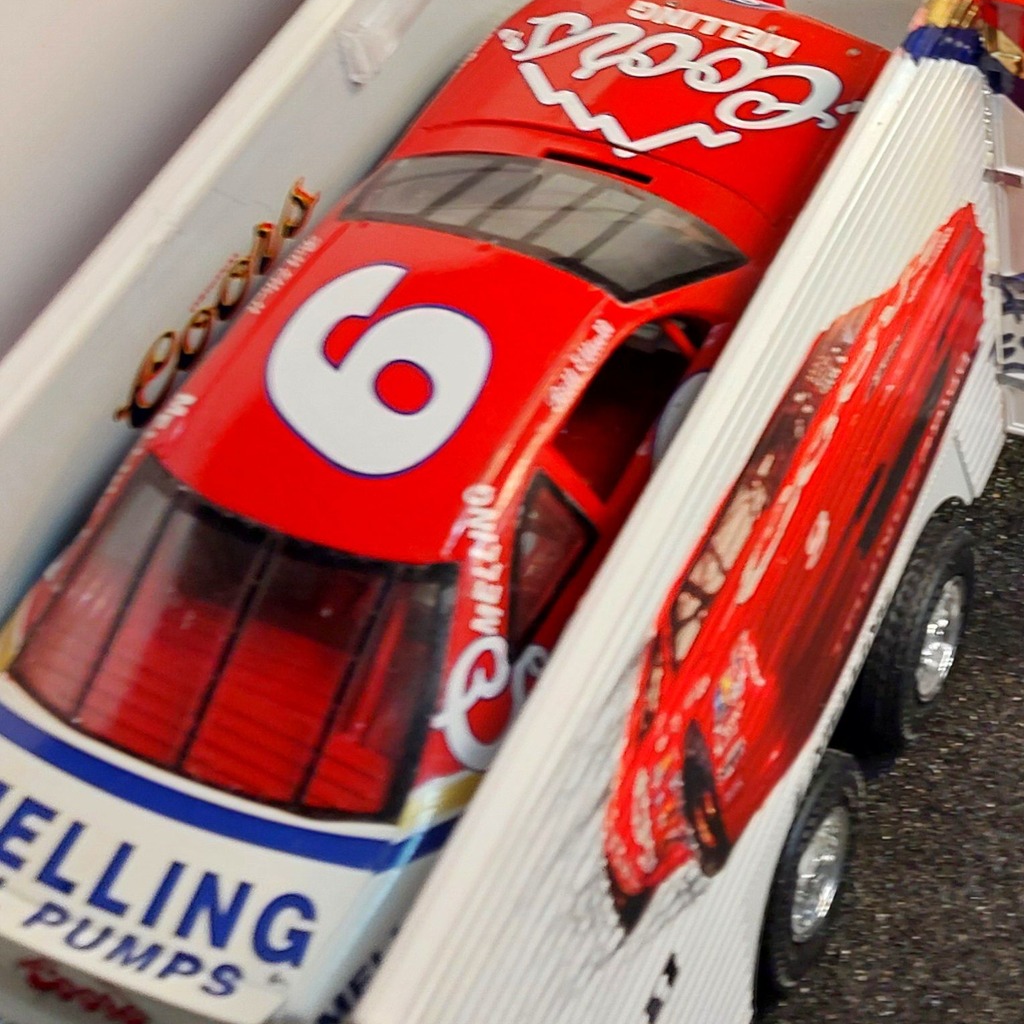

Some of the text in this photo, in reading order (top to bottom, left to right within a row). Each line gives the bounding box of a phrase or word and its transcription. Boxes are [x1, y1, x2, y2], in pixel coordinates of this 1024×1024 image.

[497, 11, 866, 131] Coors
[626, 0, 801, 59] MELLING
[0, 781, 317, 968] ELLING
[22, 900, 246, 997] PUMPS
